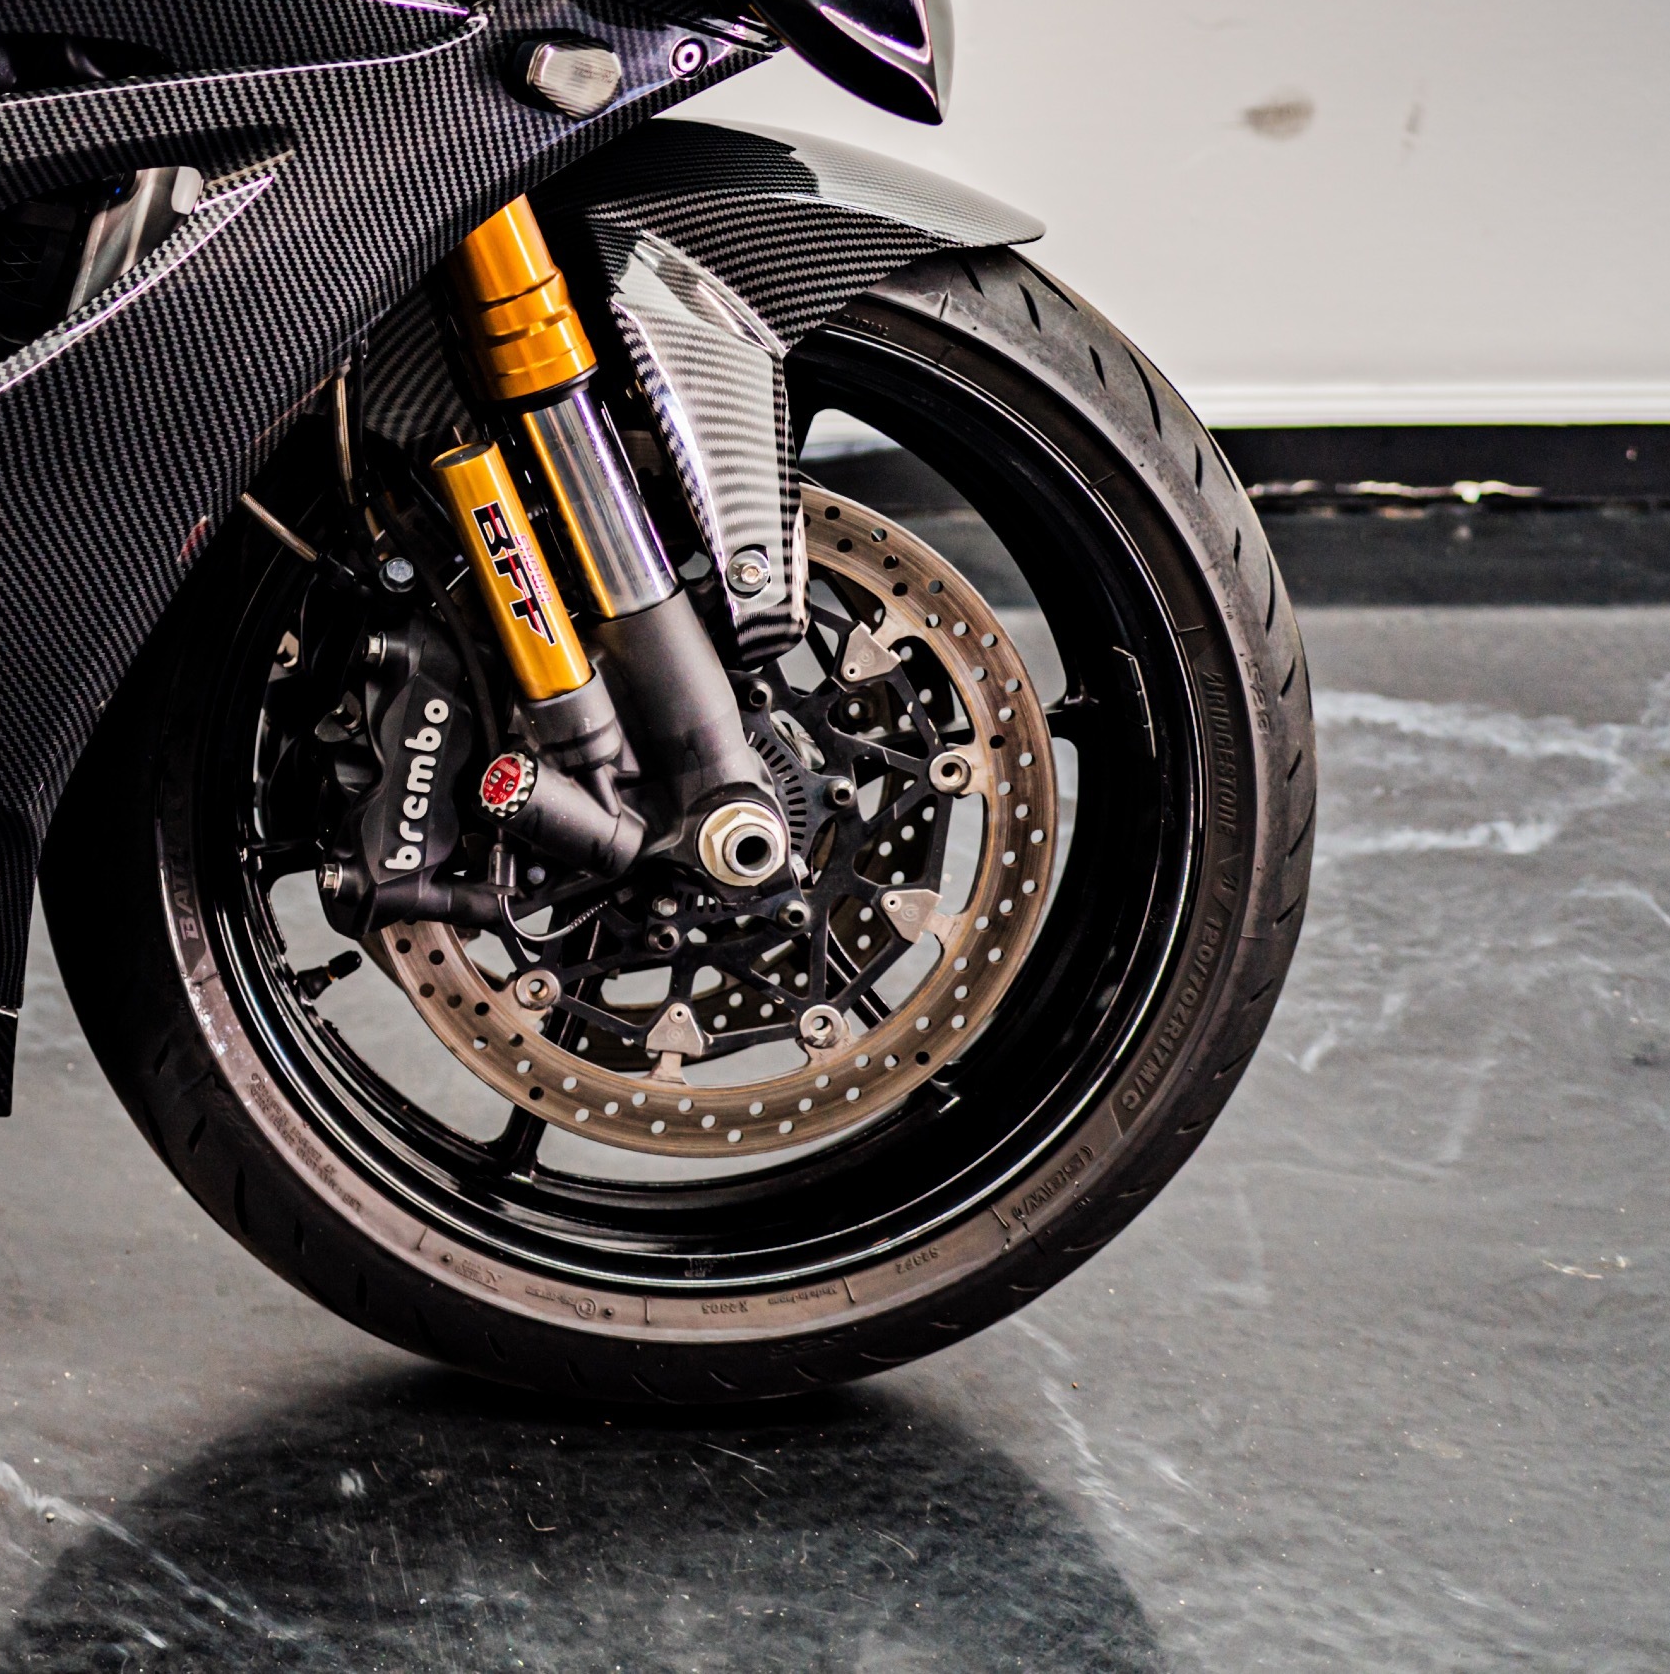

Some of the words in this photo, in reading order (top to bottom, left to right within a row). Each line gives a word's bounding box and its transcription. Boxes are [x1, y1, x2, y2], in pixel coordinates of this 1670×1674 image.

[471, 500, 557, 647] BFF
[513, 533, 553, 604] SHOWA
[384, 698, 449, 871] brembo
[1202, 671, 1238, 836] BRIDGESTONE
[1122, 916, 1225, 1113] 120/70ZR17M/C
